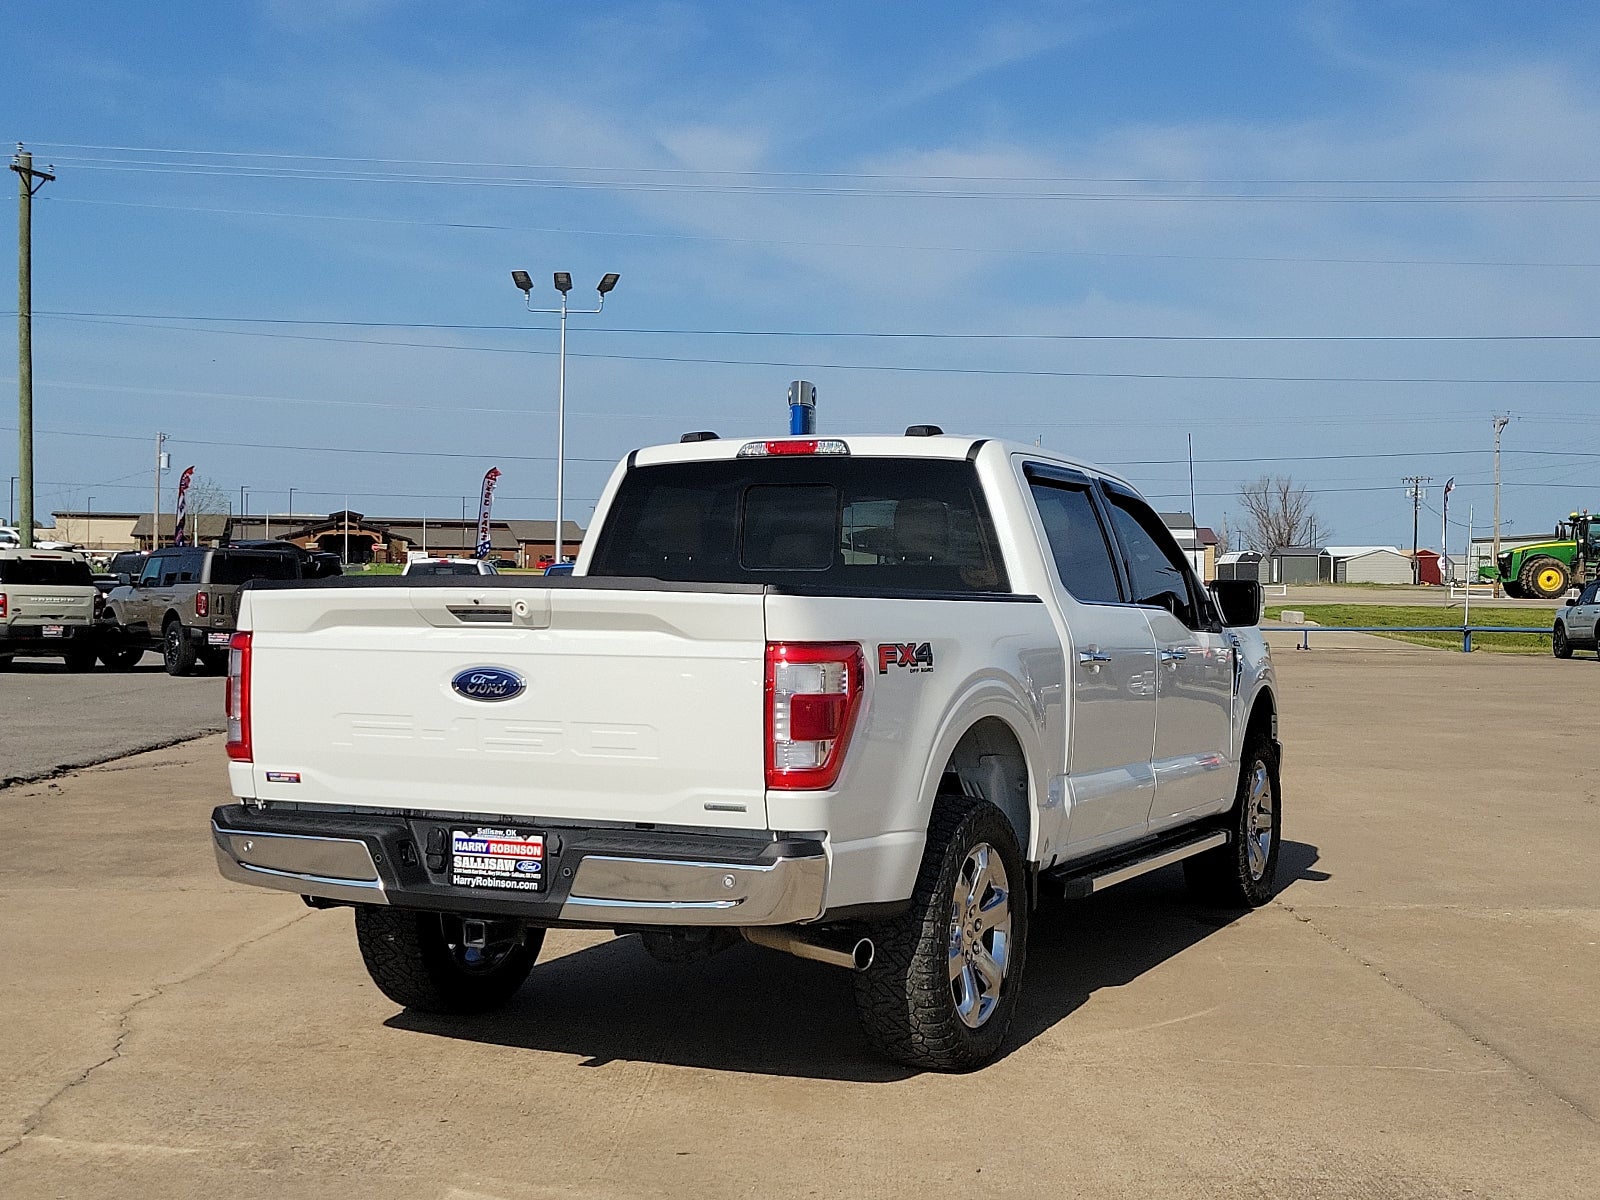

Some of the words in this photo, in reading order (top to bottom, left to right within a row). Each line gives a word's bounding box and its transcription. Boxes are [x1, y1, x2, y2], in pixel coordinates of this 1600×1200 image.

[878, 642, 933, 674] FX4
[466, 673, 508, 694] Ford
[477, 828, 505, 836] Sallisaw,
[505, 829, 517, 837] OK
[454, 841, 488, 852] HARRY
[489, 843, 541, 856] ROBINSON
[453, 855, 516, 872] SALLISAW
[453, 875, 537, 890] HarryRobinson.com
